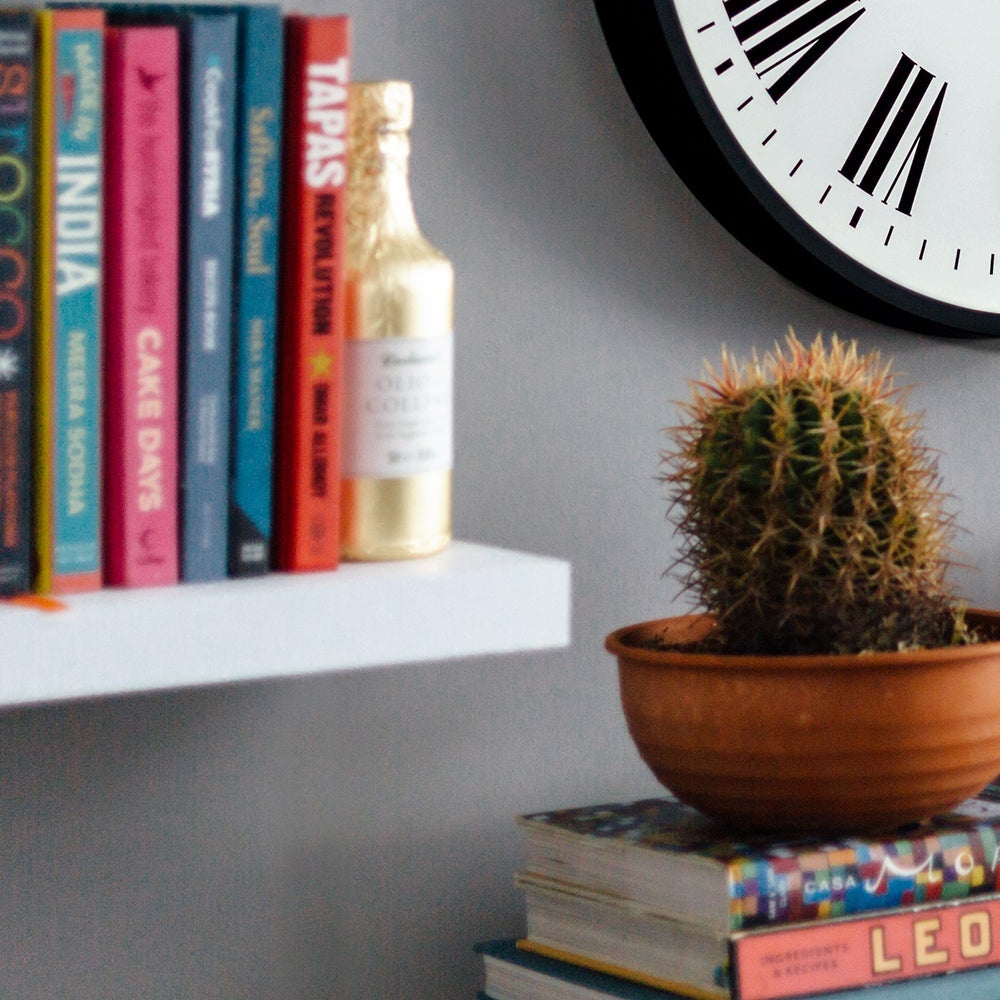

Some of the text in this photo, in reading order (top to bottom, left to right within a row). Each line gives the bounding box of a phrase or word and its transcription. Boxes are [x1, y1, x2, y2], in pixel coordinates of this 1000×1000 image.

[57, 154, 99, 297] INDIA
[304, 55, 348, 336] TAPAS REVOLUTION
[67, 329, 87, 421] MEERA
[137, 326, 164, 513] CAKE DAYS
[804, 876, 856, 895] CASA
